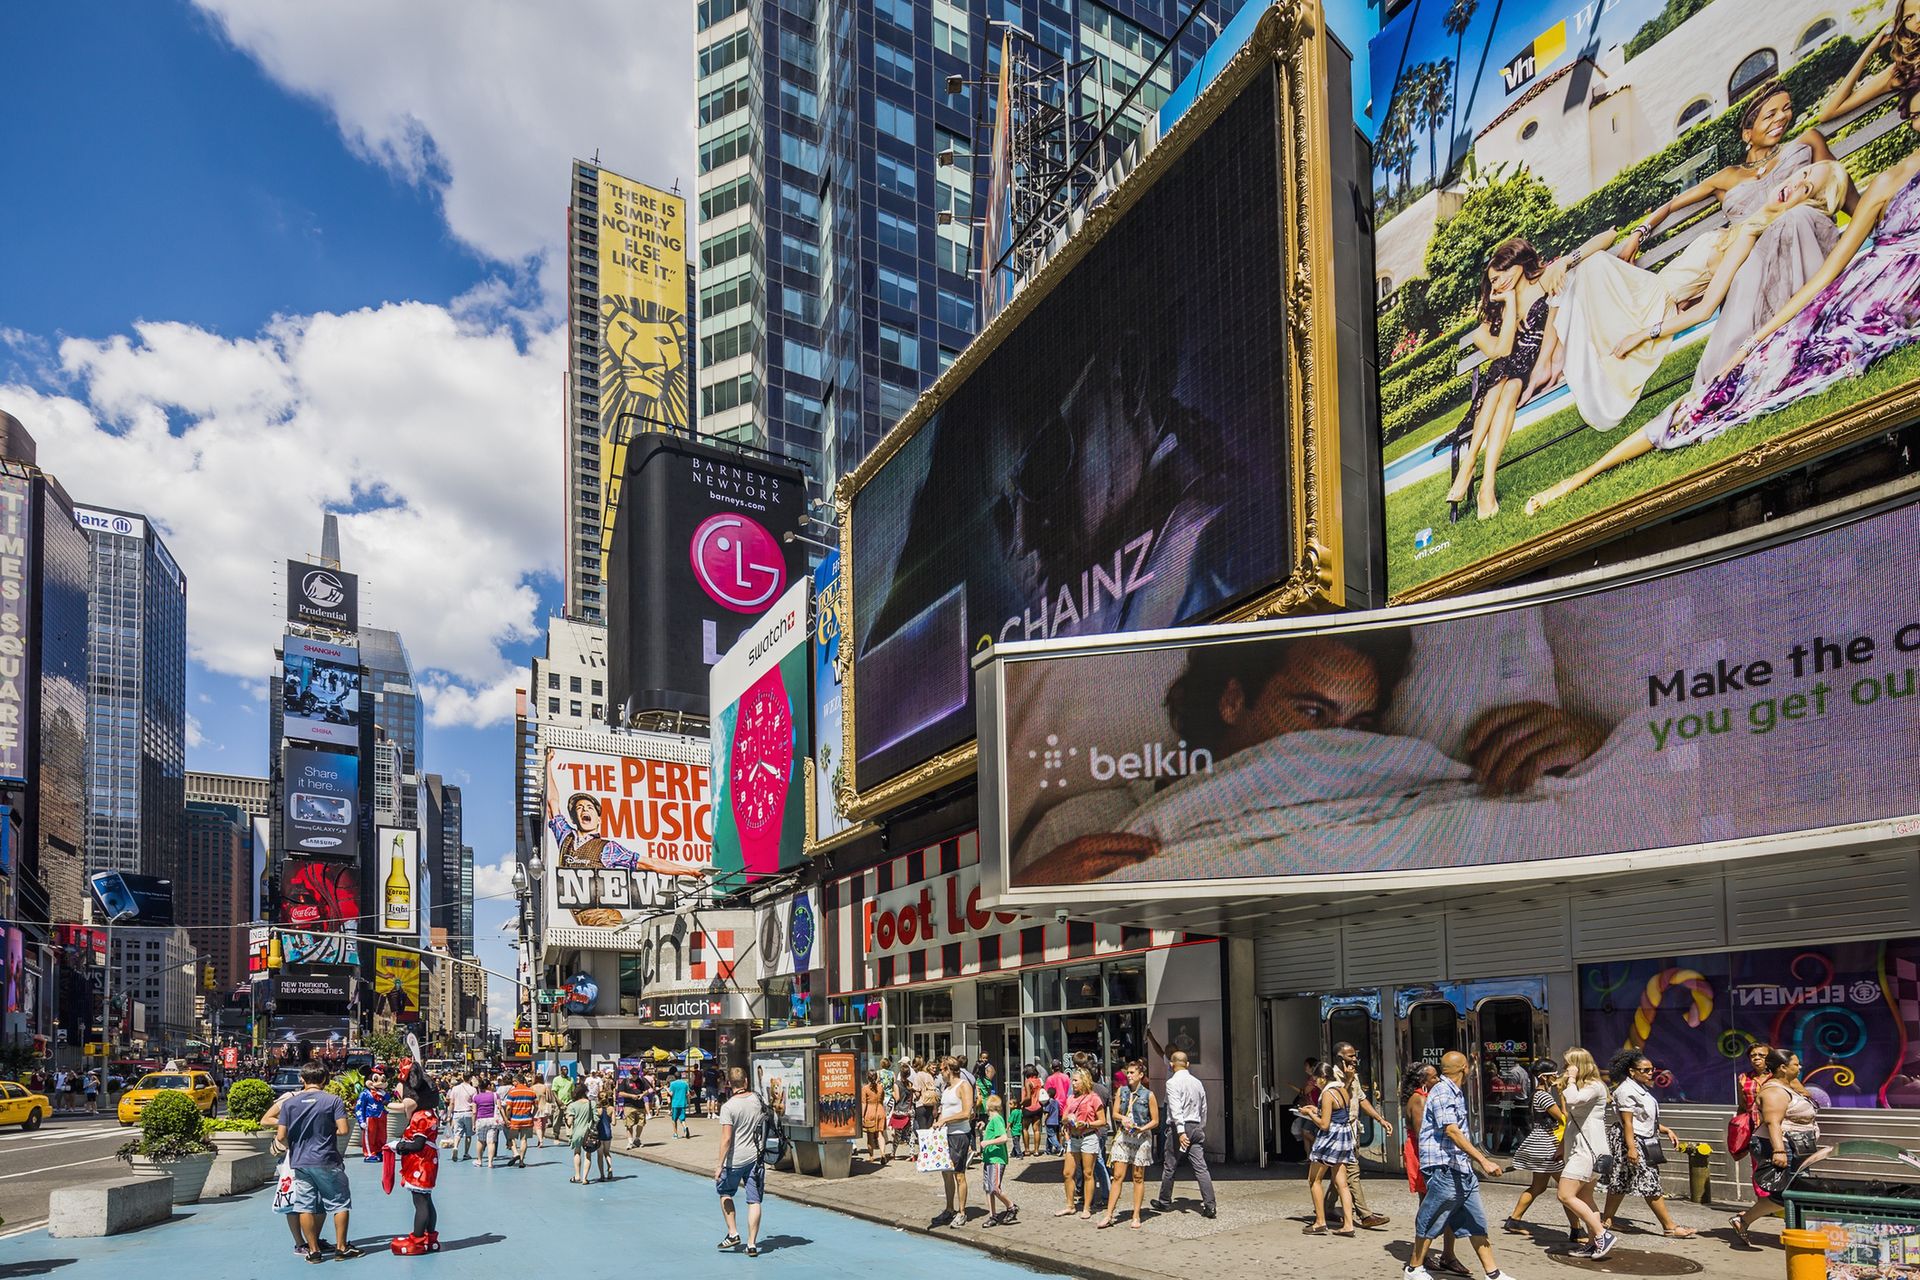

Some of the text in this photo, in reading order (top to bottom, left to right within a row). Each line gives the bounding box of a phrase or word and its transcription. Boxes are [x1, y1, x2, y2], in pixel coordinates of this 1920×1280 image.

[604, 181, 676, 218] "THERE IS
[614, 202, 670, 232] SIMPLY
[602, 214, 682, 252] NOTHING
[625, 238, 660, 262] ELSE
[613, 250, 648, 275] LIKE
[693, 458, 780, 488] BARNEYS
[709, 491, 766, 512] barneys.com
[0, 492, 25, 601] TIMES
[1000, 529, 1154, 642] CHAINZ
[299, 604, 347, 621] Prudential
[303, 645, 342, 657] SHANGHAI
[748, 616, 787, 667] swatch
[0, 612, 25, 748] SQUARE
[1649, 658, 1773, 707] Make
[1787, 634, 1875, 678] the
[1649, 706, 1732, 751] you
[1750, 681, 1832, 734] get
[312, 727, 333, 736] CHINA
[1090, 740, 1213, 781] belkin
[298, 777, 344, 793] it here...
[304, 766, 338, 780] Share
[621, 757, 711, 802] PERF
[564, 854, 591, 867] Disney
[647, 842, 679, 861] FOR
[387, 888, 409, 896] Corona
[388, 903, 408, 914] Light
[863, 889, 935, 954] Foot
[659, 1000, 710, 1017] swatch
[1421, 1058, 1443, 1066] ONL
[1422, 1048, 1445, 1056] EXIT
[787, 1080, 804, 1100] ted
